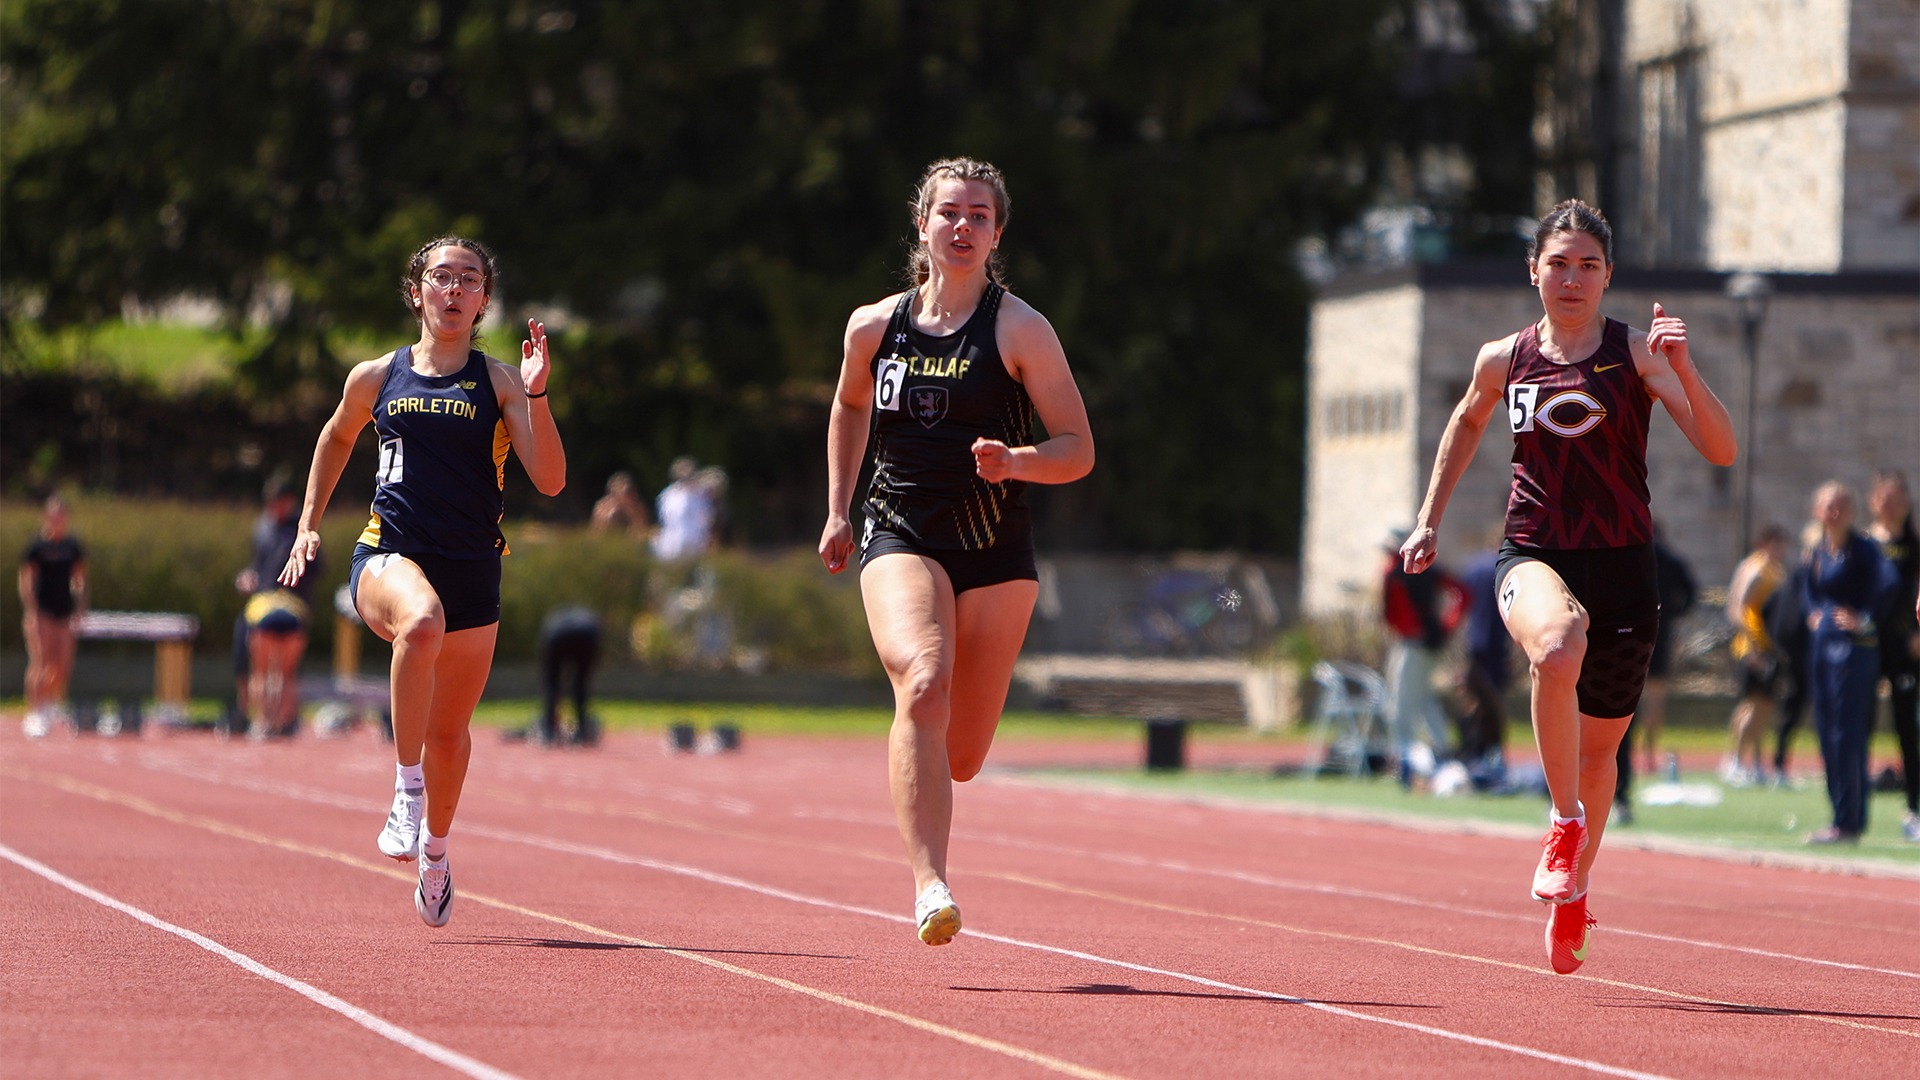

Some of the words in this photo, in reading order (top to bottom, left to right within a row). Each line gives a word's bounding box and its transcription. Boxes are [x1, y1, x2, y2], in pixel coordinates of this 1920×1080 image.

[880, 362, 899, 407] 6
[922, 356, 971, 380] OLAF
[387, 397, 477, 420] CARLETON
[1513, 388, 1530, 430] 5
[384, 441, 397, 482] 7
[1503, 581, 1514, 611] 5
